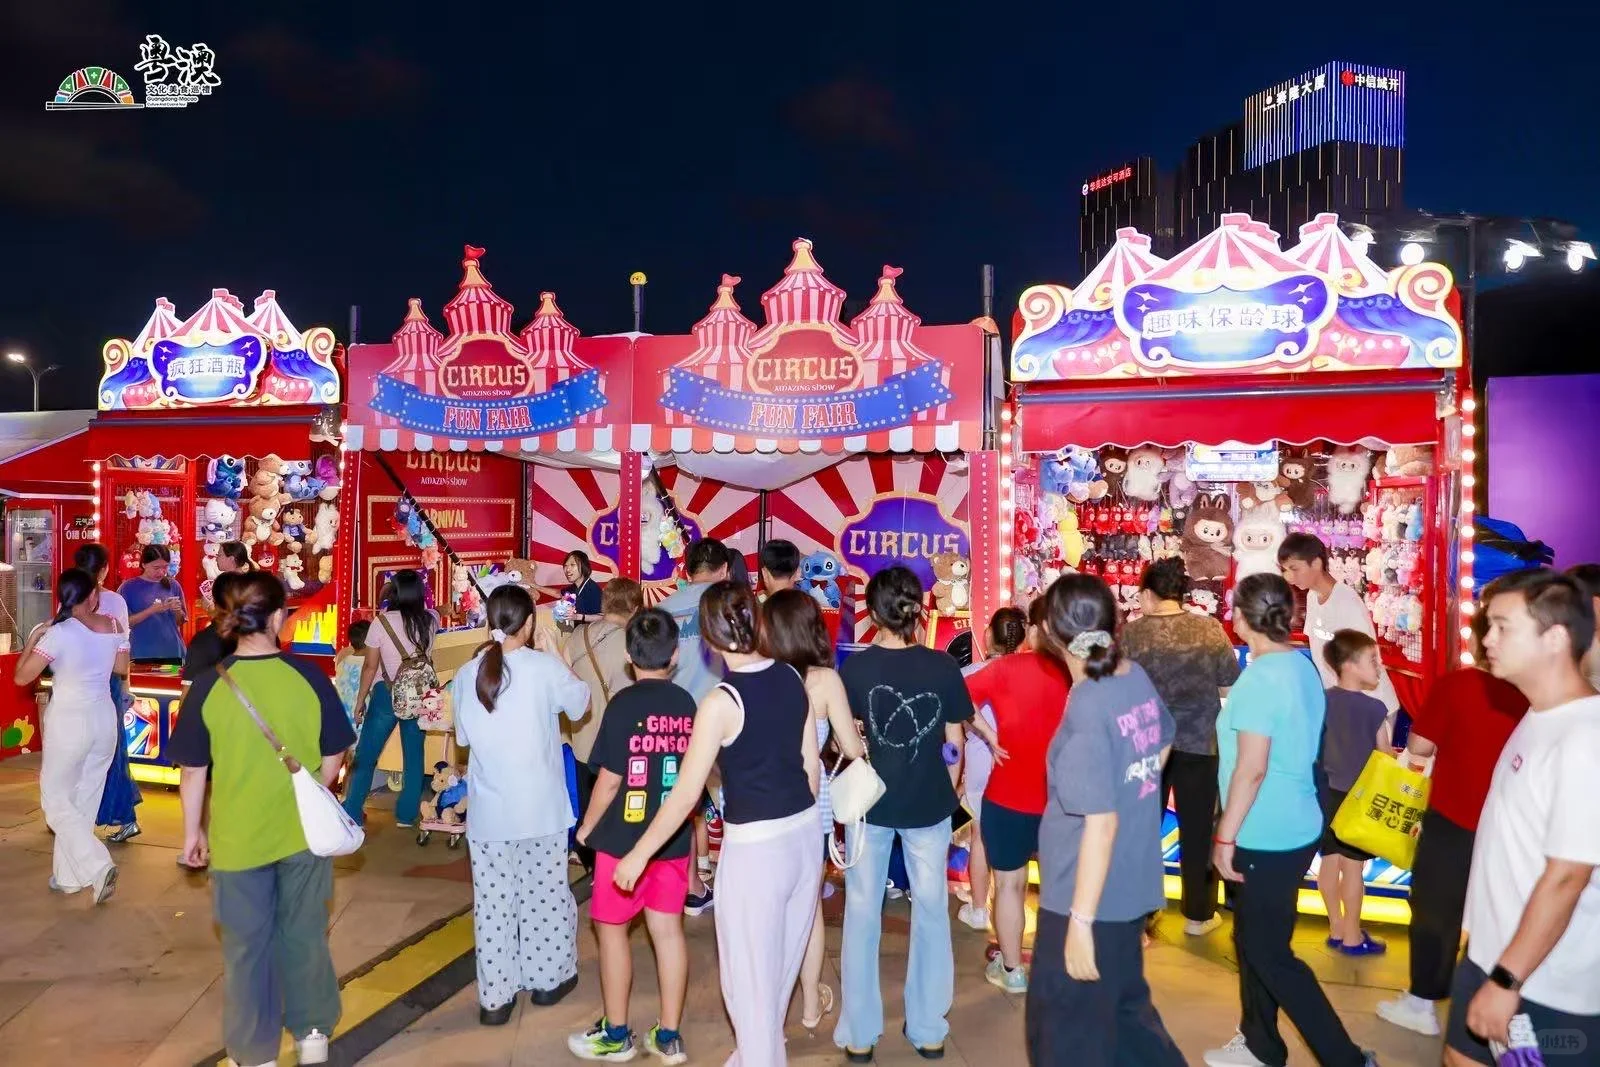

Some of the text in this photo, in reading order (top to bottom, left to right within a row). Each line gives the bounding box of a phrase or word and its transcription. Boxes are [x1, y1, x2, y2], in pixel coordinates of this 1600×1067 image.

[1355, 73, 1399, 91] 中信城开
[1147, 307, 1297, 334] 趣味保龄球
[170, 357, 243, 377] 疯狂酒瓶
[447, 364, 526, 387] CIRCUS
[757, 356, 854, 382] CIRCUS
[443, 405, 532, 431] FUN FAIR
[749, 401, 858, 429] FUN FAIR
[849, 530, 960, 558] CIRCUS
[647, 715, 692, 733] GAME
[629, 735, 688, 753] CONSO
